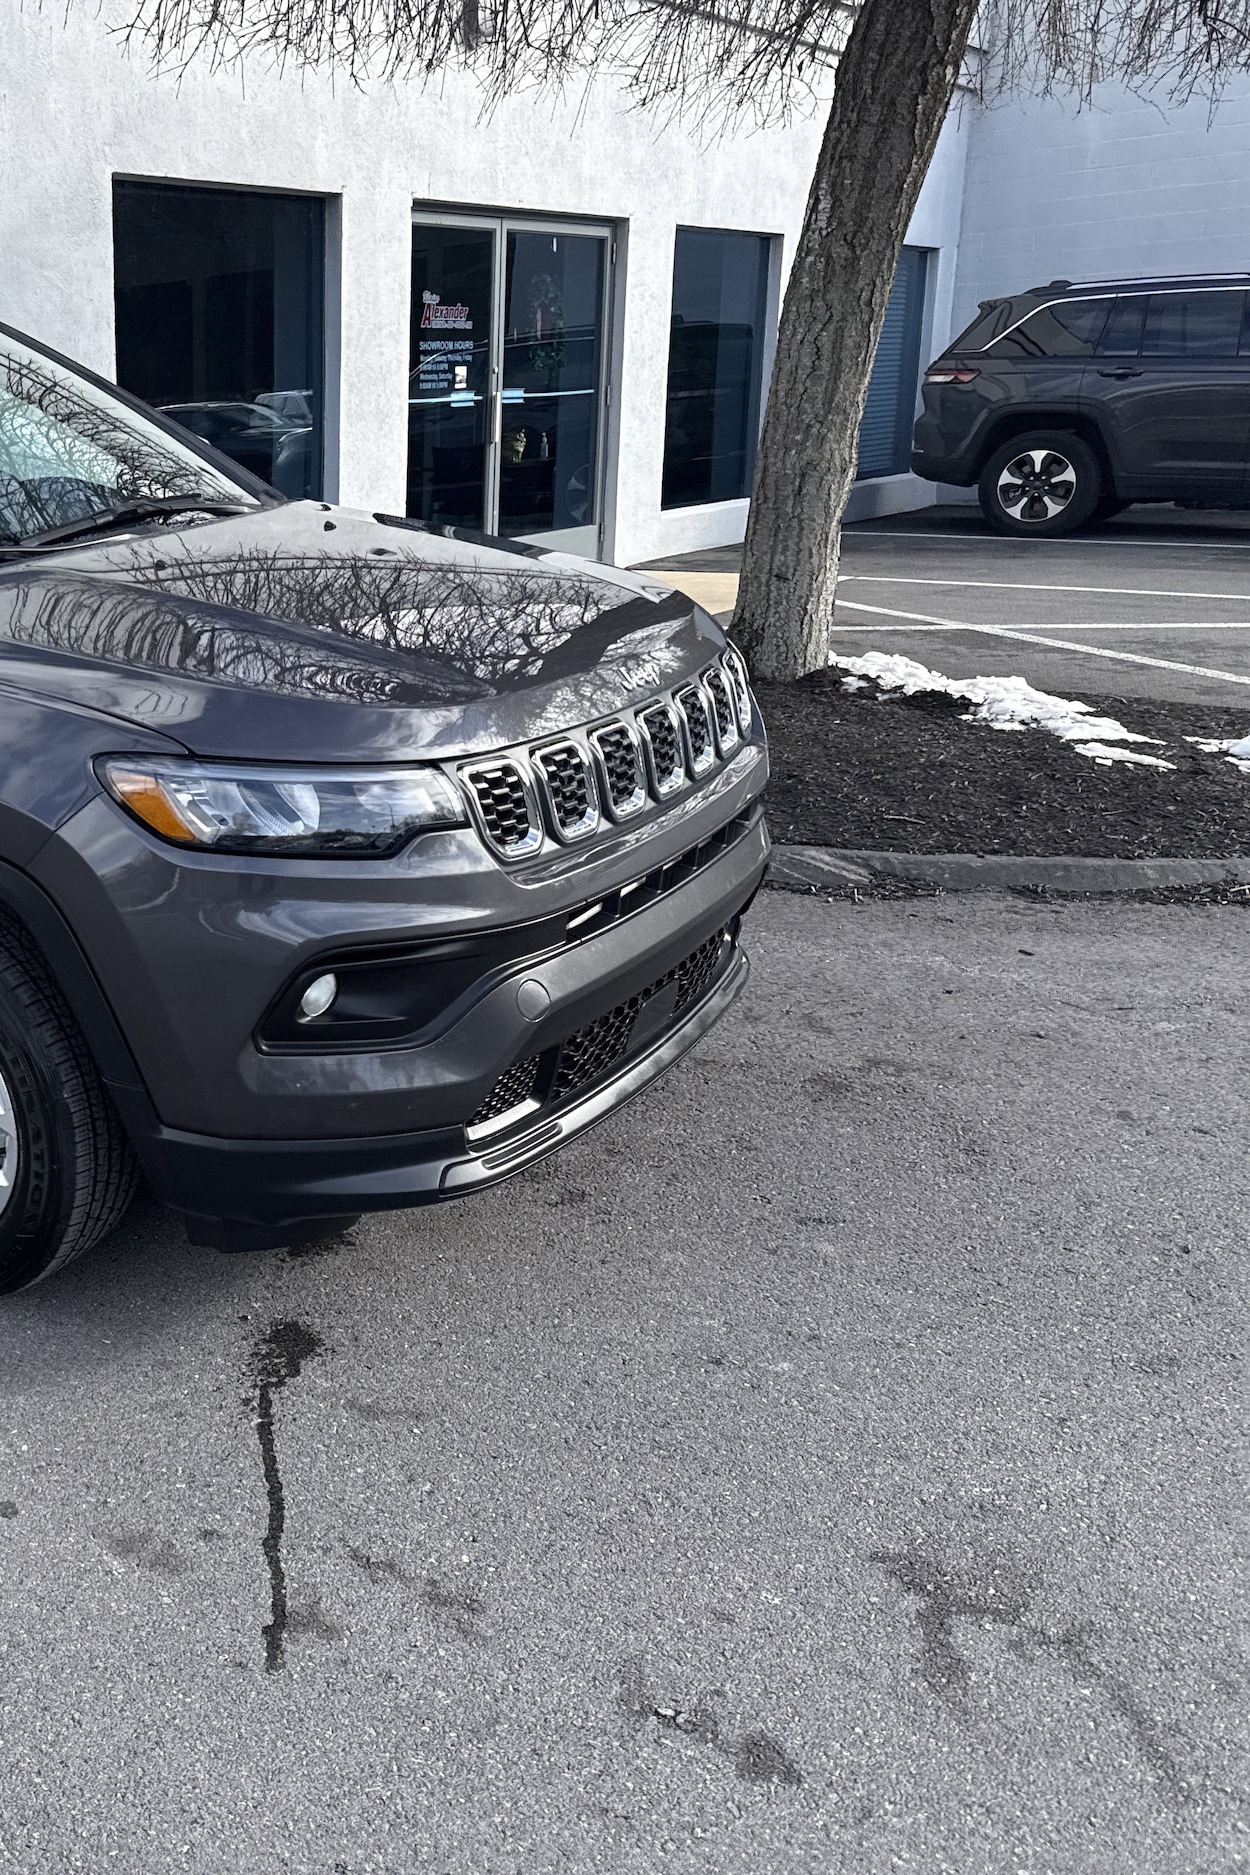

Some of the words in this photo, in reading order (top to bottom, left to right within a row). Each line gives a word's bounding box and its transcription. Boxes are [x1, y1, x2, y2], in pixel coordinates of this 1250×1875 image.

[421, 303, 469, 328] Alexander
[419, 341, 454, 350] SHOWROOM
[454, 341, 474, 350] HOURS
[618, 661, 661, 691] Jeep
